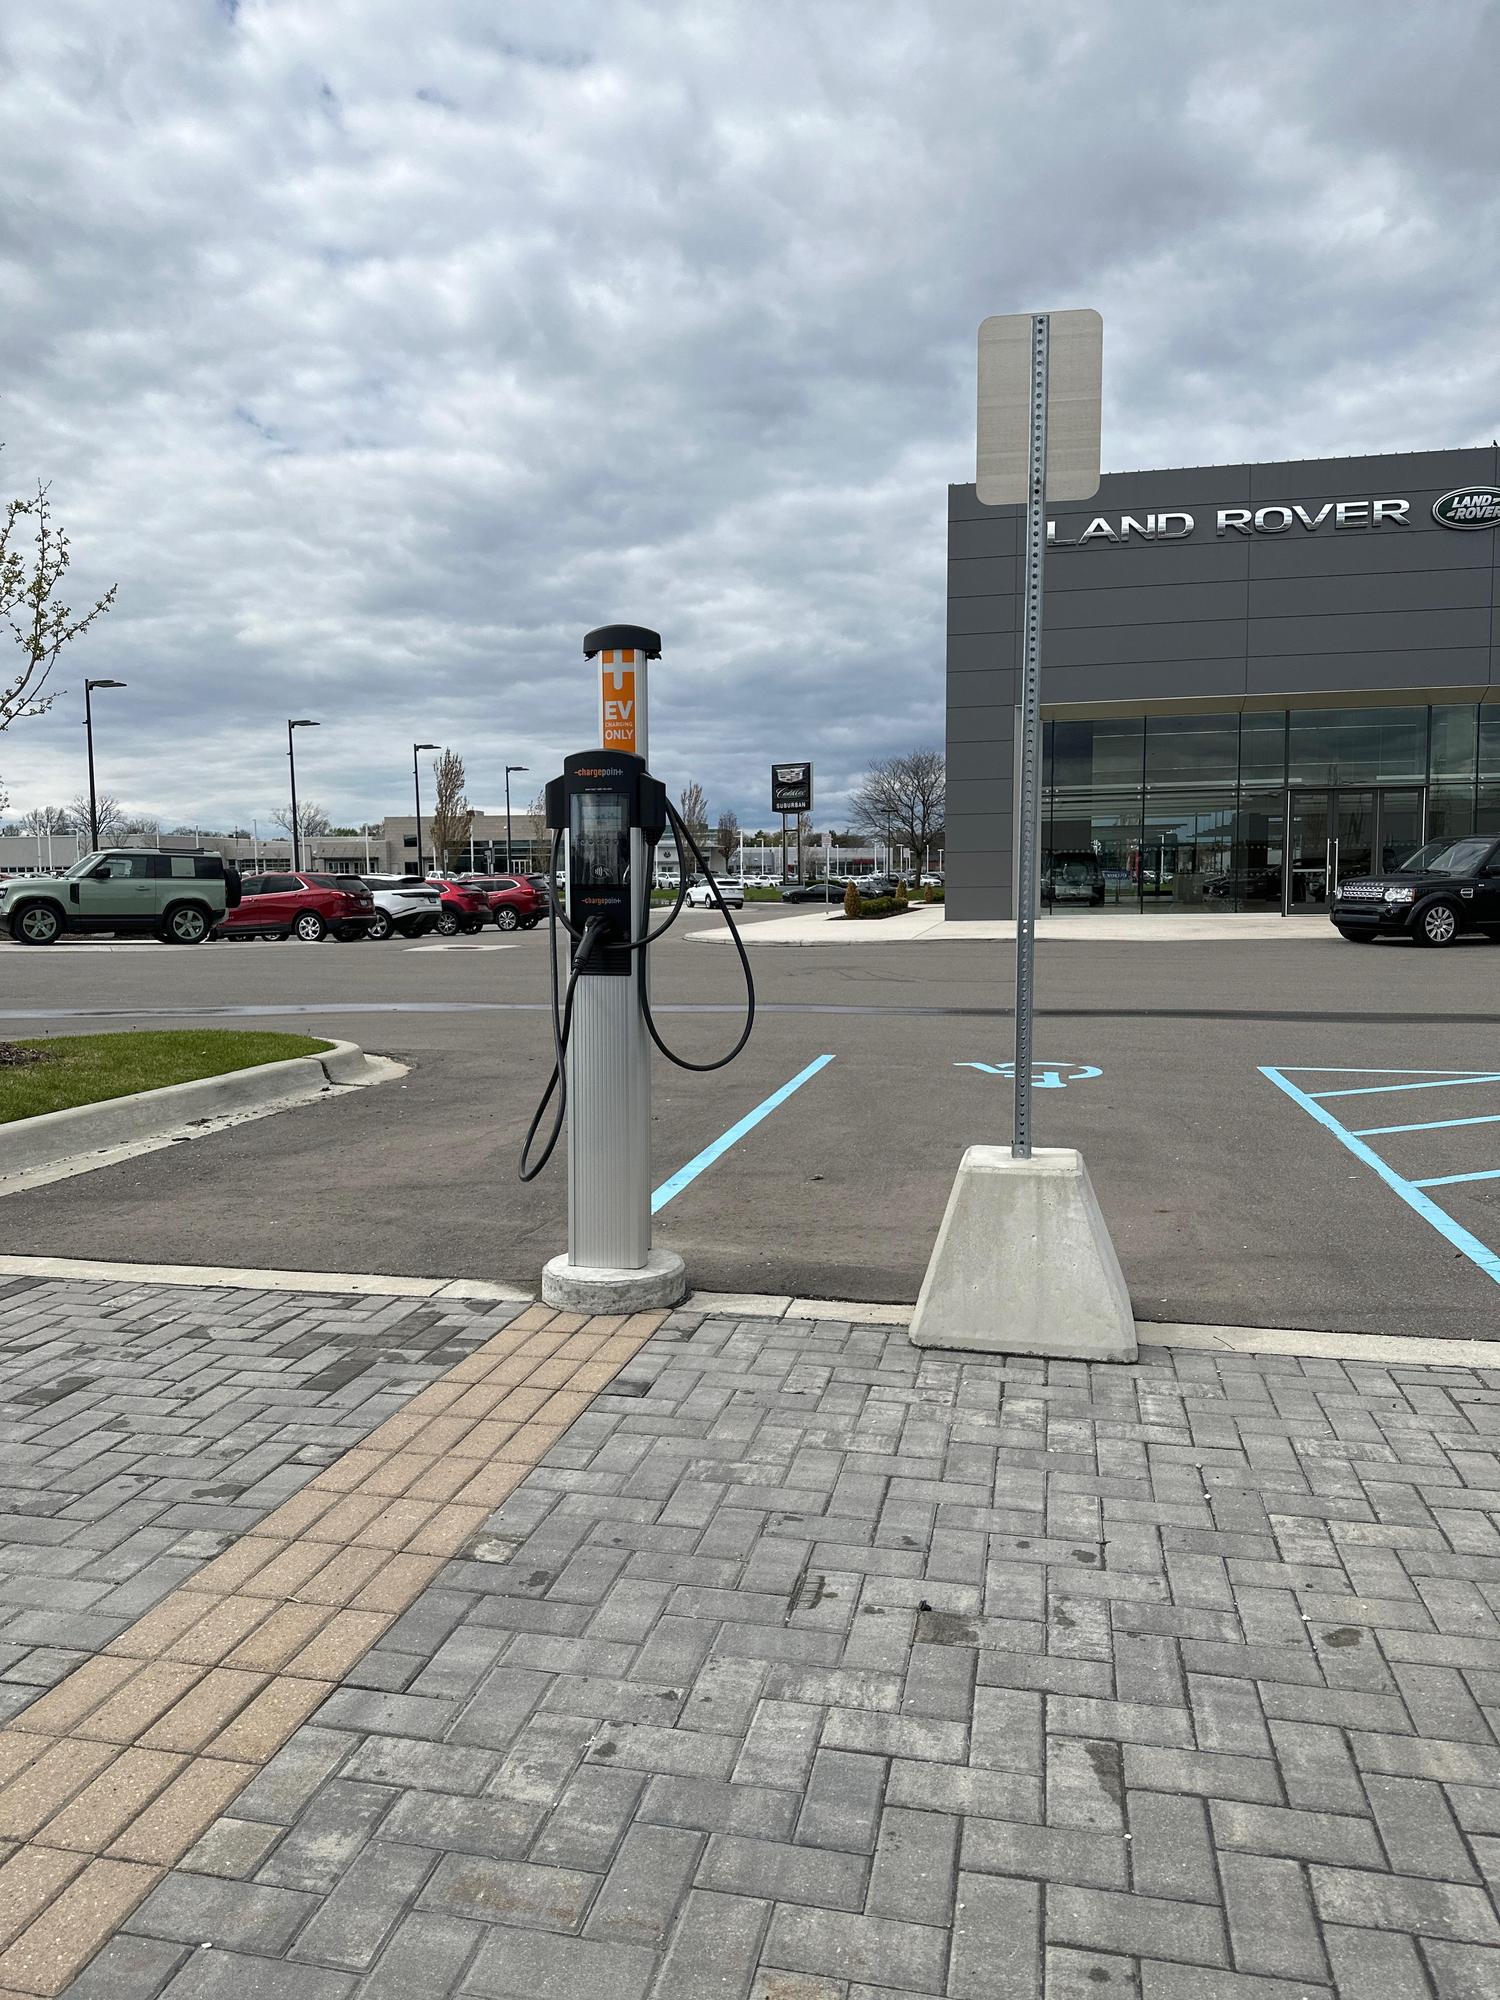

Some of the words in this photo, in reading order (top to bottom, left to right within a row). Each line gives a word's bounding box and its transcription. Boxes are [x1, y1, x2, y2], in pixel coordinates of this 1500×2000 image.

[1451, 494, 1493, 508] LAND
[1046, 512, 1195, 547] LAND
[1215, 499, 1412, 537] ROVER
[605, 700, 633, 720] EV
[605, 729, 634, 740] ONLY
[776, 801, 806, 809] SUBURBAN
